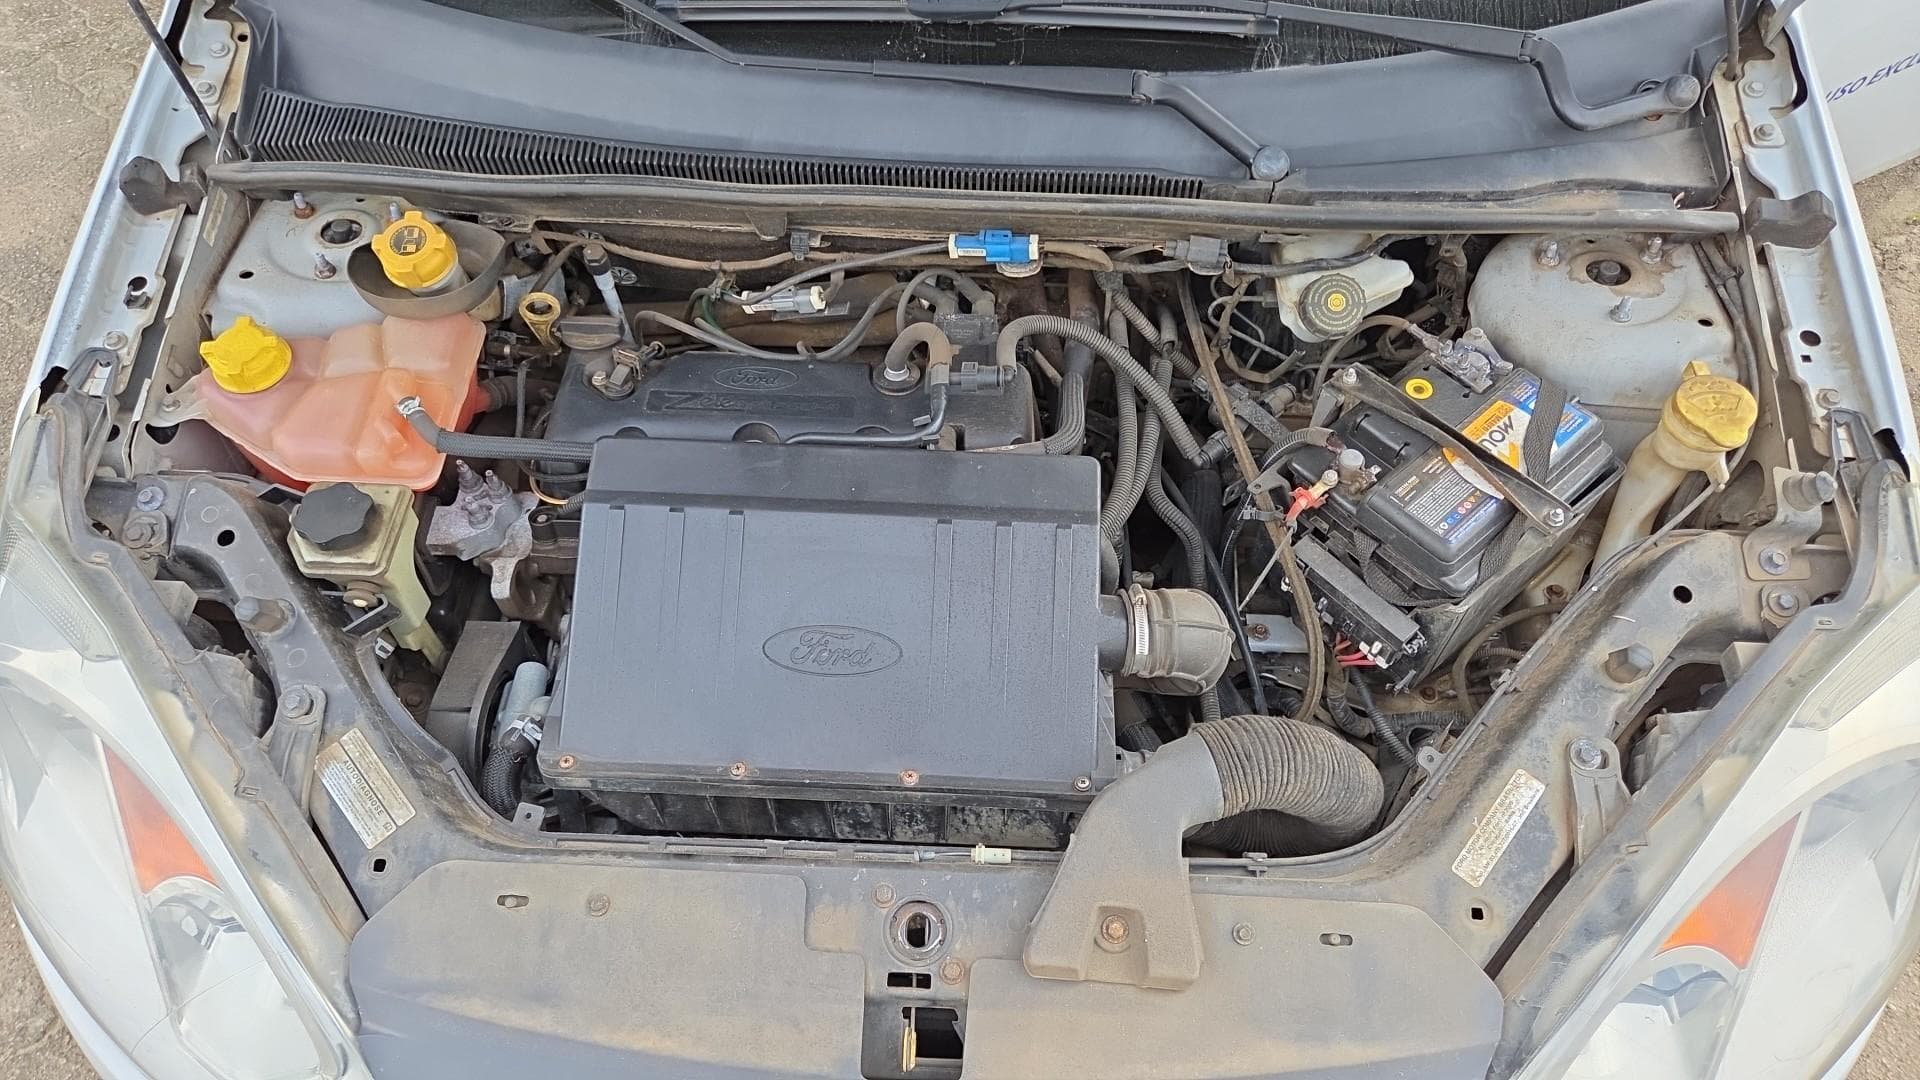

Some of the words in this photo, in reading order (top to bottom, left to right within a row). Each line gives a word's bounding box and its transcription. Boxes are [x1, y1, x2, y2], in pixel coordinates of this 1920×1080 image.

[1826, 76, 1867, 103] USO
[1867, 53, 1920, 86] EXCL
[730, 370, 780, 386] Ford
[790, 630, 874, 667] Ford
[343, 760, 384, 816] AUTODIAGNOSE
[1454, 854, 1469, 872] FORD
[1465, 833, 1482, 854] MOTOR
[1480, 806, 1498, 834] COMPANY
